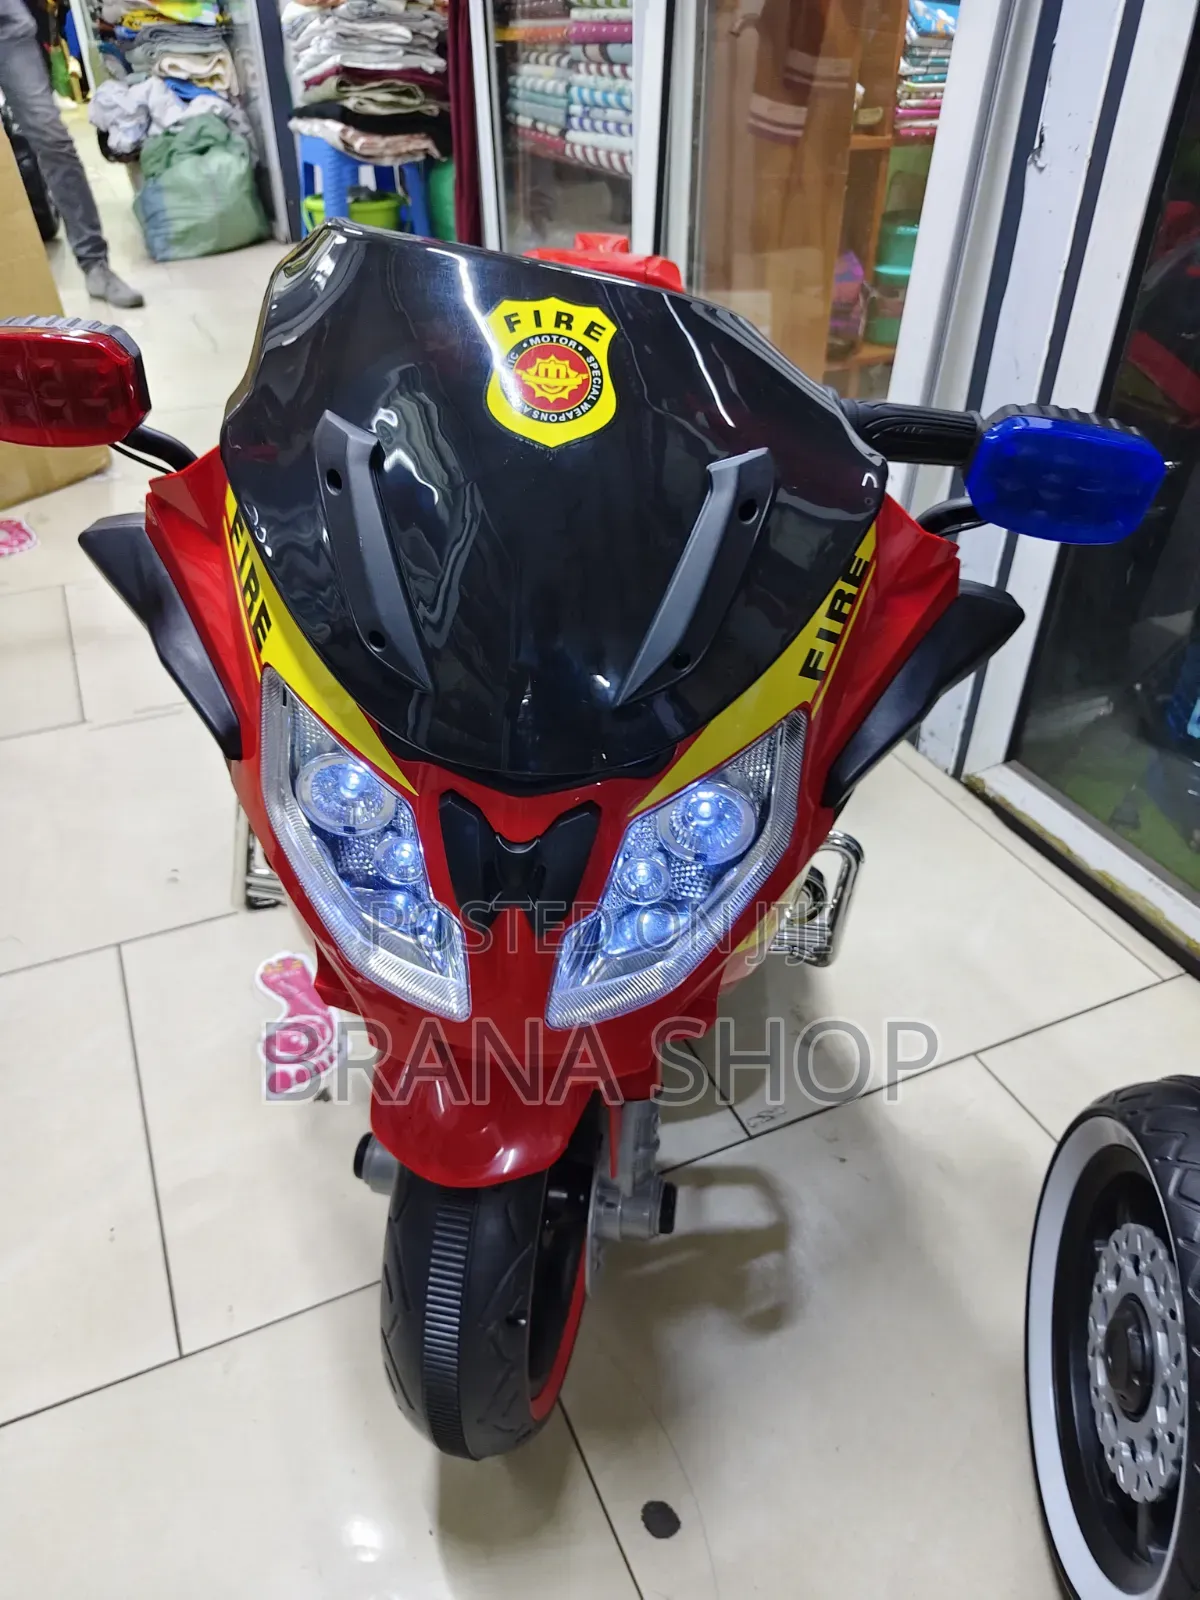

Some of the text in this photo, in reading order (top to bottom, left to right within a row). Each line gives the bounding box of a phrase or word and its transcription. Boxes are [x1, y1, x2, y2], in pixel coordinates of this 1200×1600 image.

[503, 309, 607, 343] FIRE
[528, 334, 578, 349] MOTOR
[531, 355, 602, 423] SPECIAL WEAPONS
[231, 507, 272, 654] FIRE
[798, 556, 870, 682] FIRE
